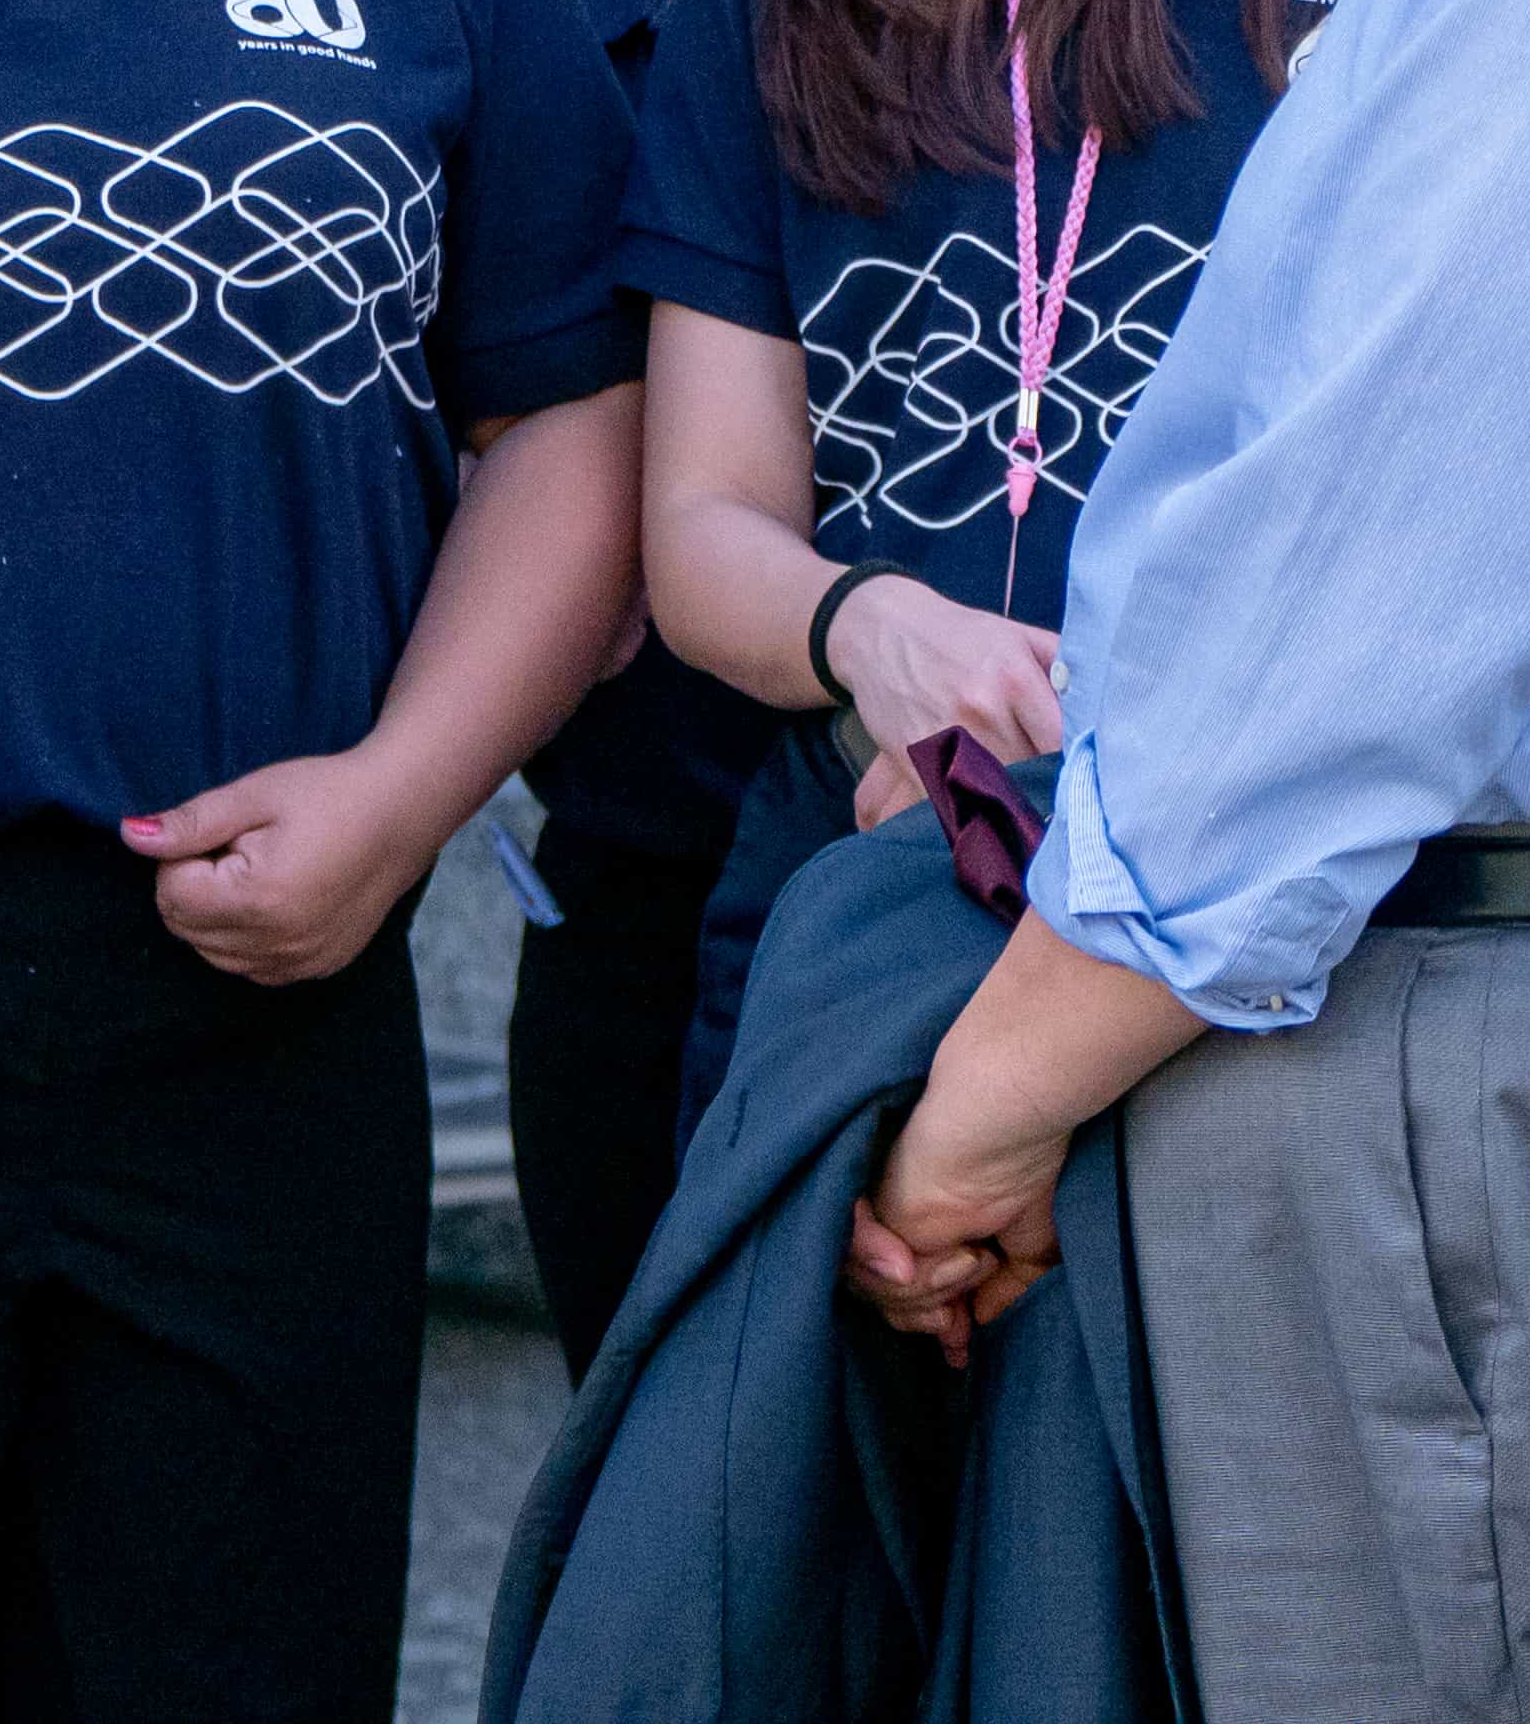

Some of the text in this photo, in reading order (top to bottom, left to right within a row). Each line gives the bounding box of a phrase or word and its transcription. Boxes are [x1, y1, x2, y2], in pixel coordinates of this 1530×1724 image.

[237, 39, 378, 70] years in good hands
